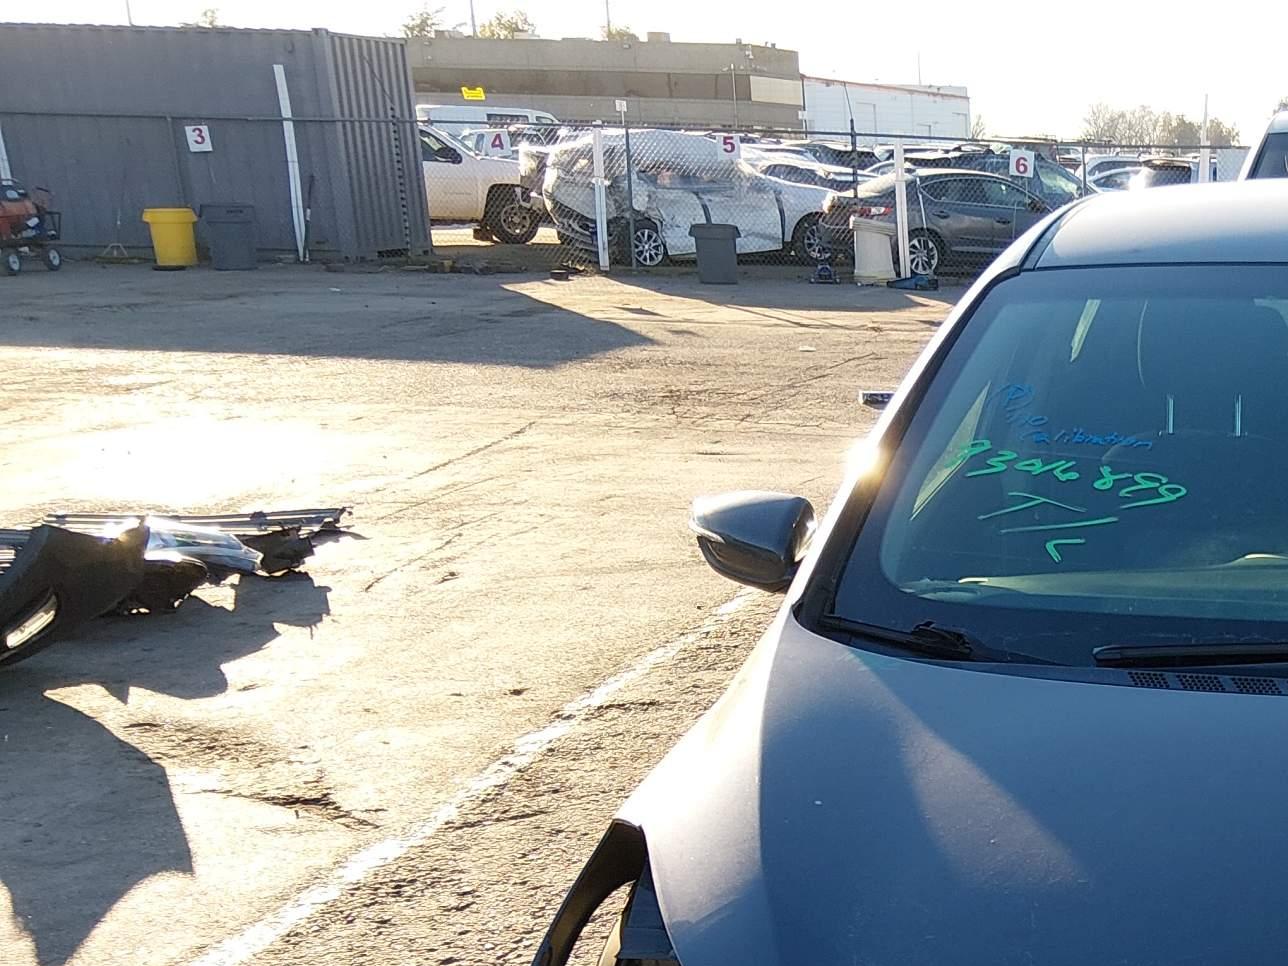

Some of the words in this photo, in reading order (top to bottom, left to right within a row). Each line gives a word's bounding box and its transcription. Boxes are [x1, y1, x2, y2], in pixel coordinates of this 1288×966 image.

[191, 127, 206, 145] 3
[490, 133, 504, 150] 4
[722, 135, 736, 153] 5
[1015, 156, 1028, 174] 6
